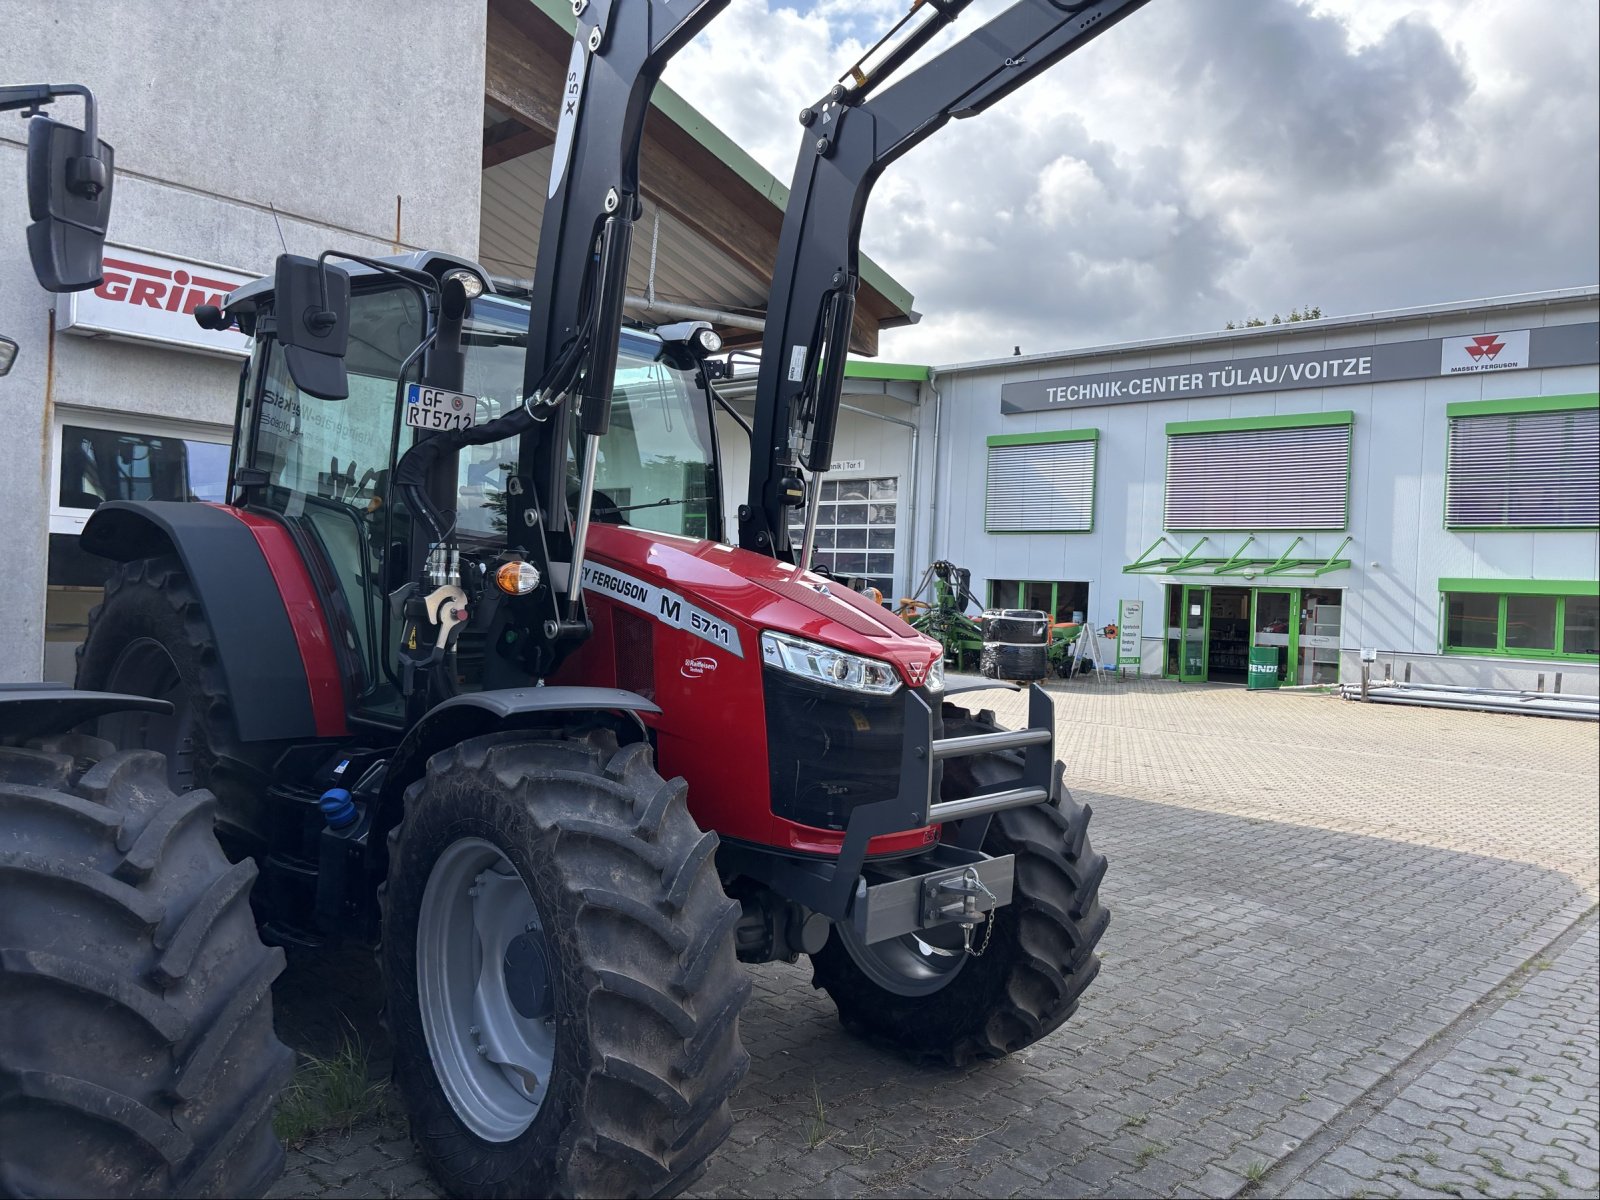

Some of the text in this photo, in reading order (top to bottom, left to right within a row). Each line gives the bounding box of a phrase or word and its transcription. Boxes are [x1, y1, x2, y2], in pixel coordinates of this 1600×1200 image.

[1450, 362, 1518, 373] MASSEY FERGUSON
[1046, 356, 1372, 403] TECHNIK-CENTER TÜLAU/VOITZE
[423, 389, 445, 408] GF
[592, 571, 648, 602] FERGUSON
[660, 594, 682, 623] M
[690, 612, 730, 645] 5711
[1249, 663, 1278, 673] FENDT
